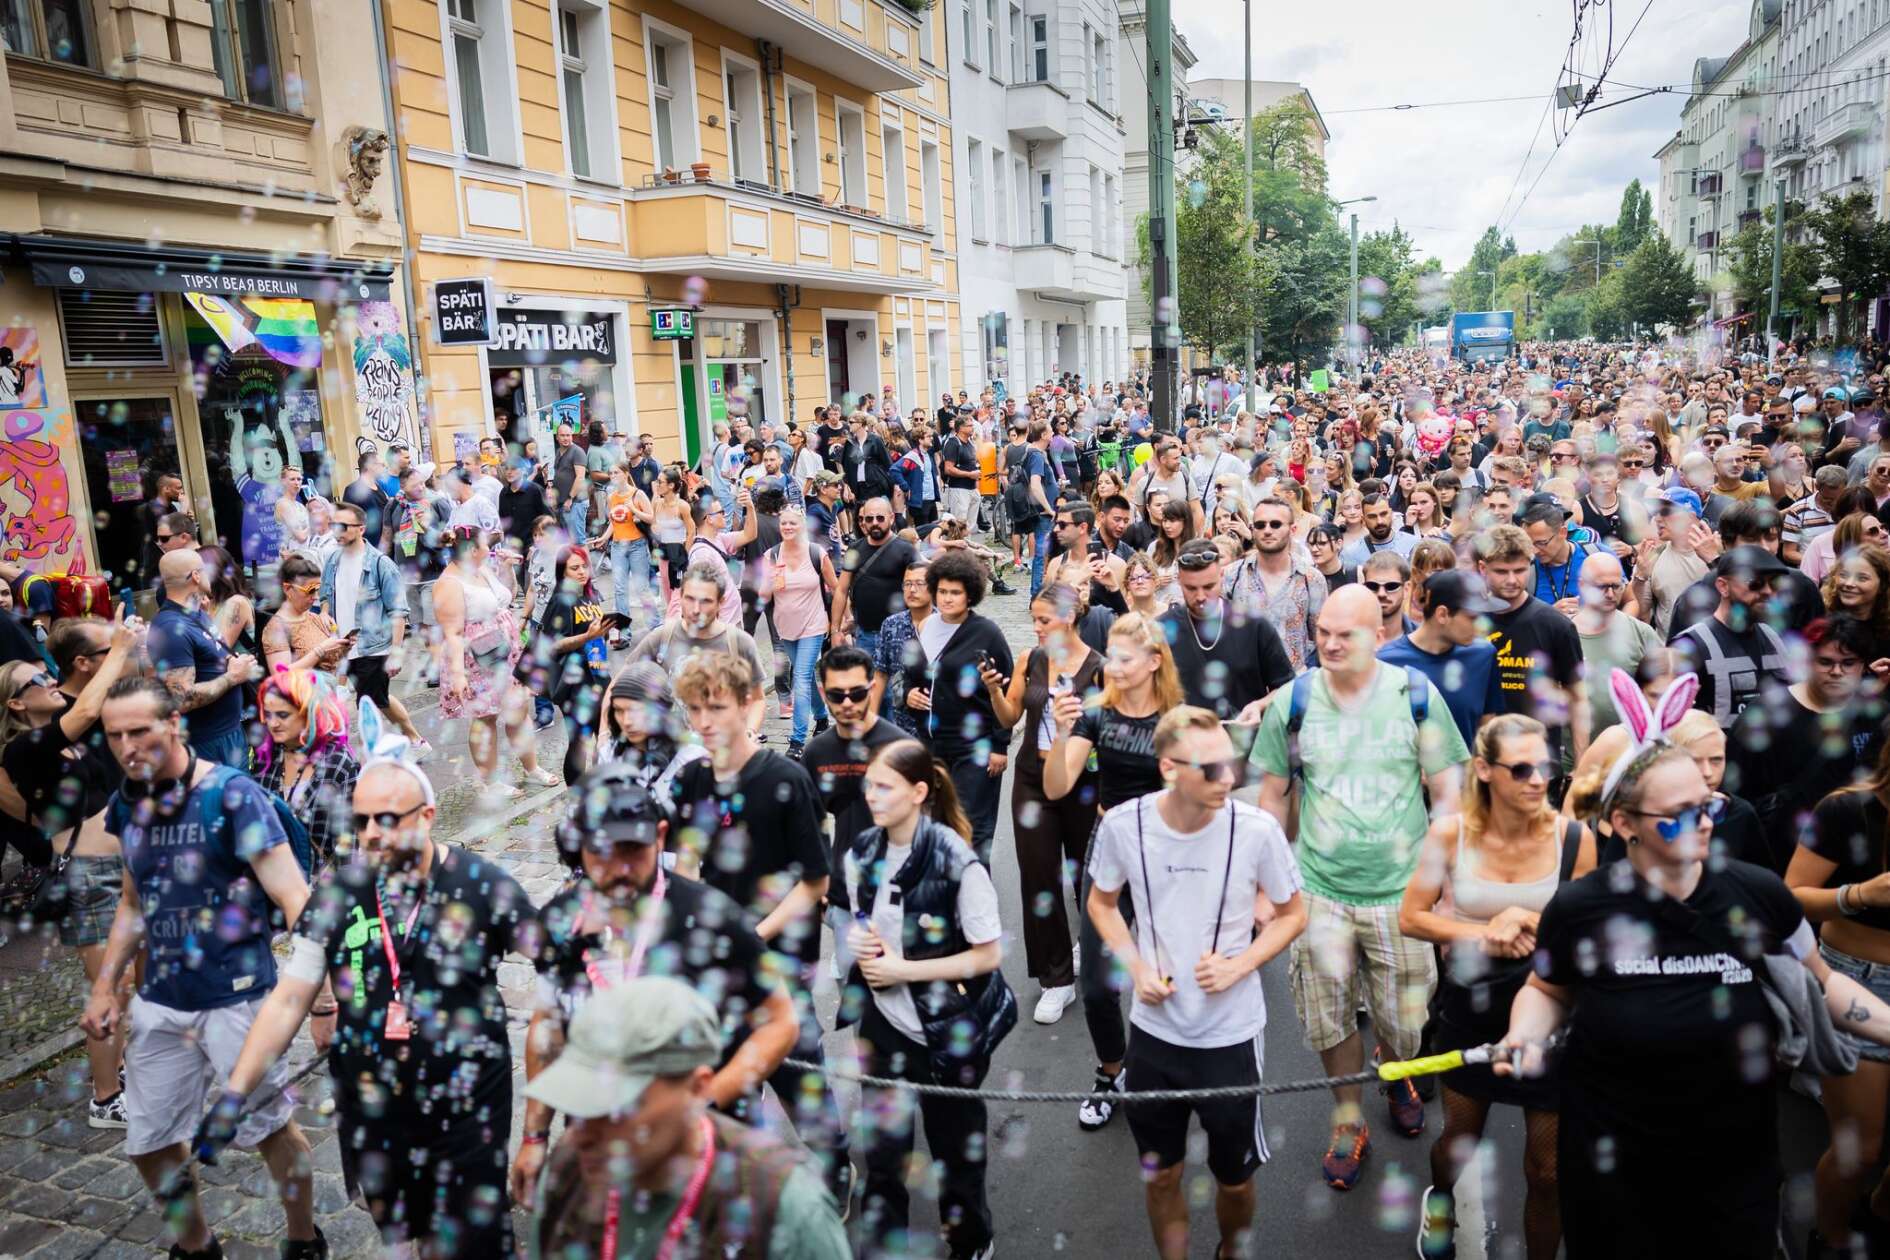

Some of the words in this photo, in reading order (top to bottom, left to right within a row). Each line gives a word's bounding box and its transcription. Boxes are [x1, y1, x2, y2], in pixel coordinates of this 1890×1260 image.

[181, 274, 218, 289] TIPSY
[257, 280, 299, 295] BERLIN
[439, 289, 482, 309] SPÄTI
[442, 311, 475, 331] BÄR
[367, 386, 402, 402] PEOPLE
[152, 917, 213, 938] CRIM
[1614, 956, 1661, 975] social
[1662, 952, 1745, 975] disDANCIN
